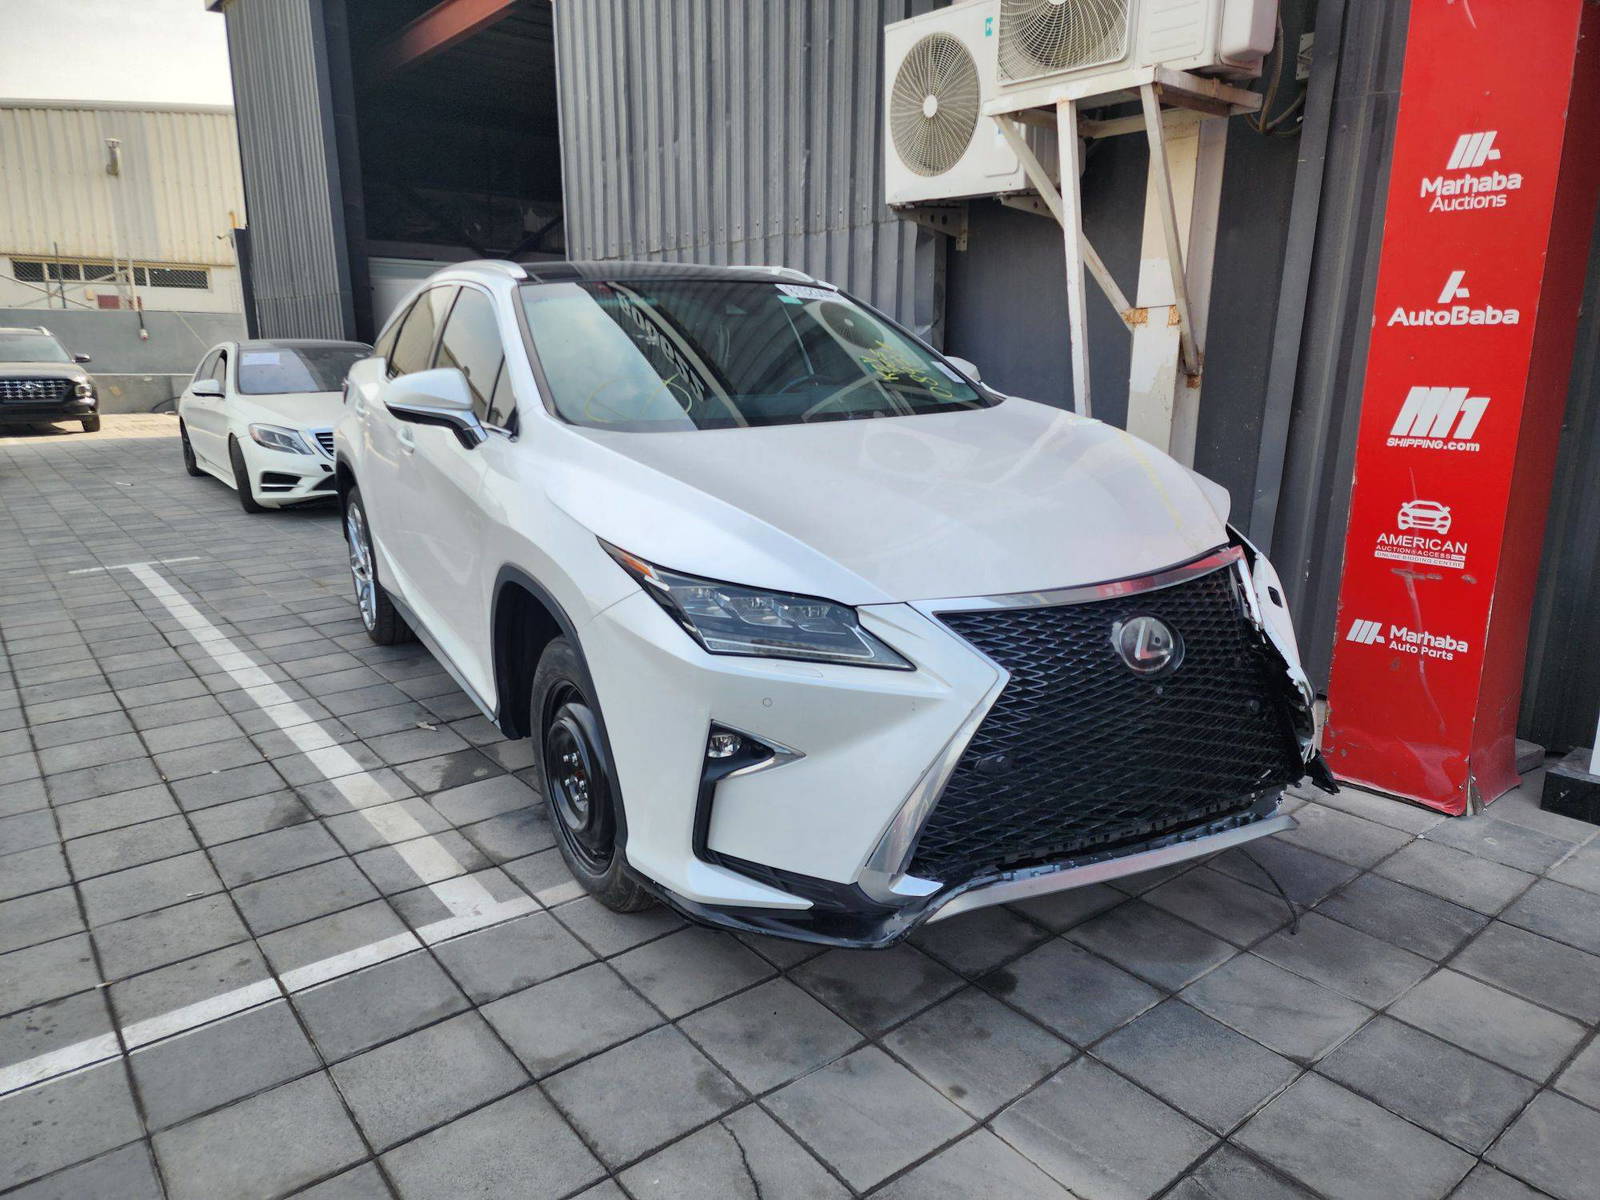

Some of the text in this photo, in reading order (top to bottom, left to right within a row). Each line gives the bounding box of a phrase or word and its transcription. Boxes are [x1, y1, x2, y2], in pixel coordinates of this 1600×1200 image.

[1420, 171, 1522, 198] Marhaba
[1429, 193, 1507, 213] Auctions
[1387, 305, 1520, 327] AutoBaba
[1386, 437, 1480, 452] SHIPPING.com
[1376, 532, 1468, 554] AMERICAN
[1402, 554, 1432, 565] BIDDING
[1389, 624, 1469, 653] Marhaba
[1389, 640, 1454, 661] Auto Parts
